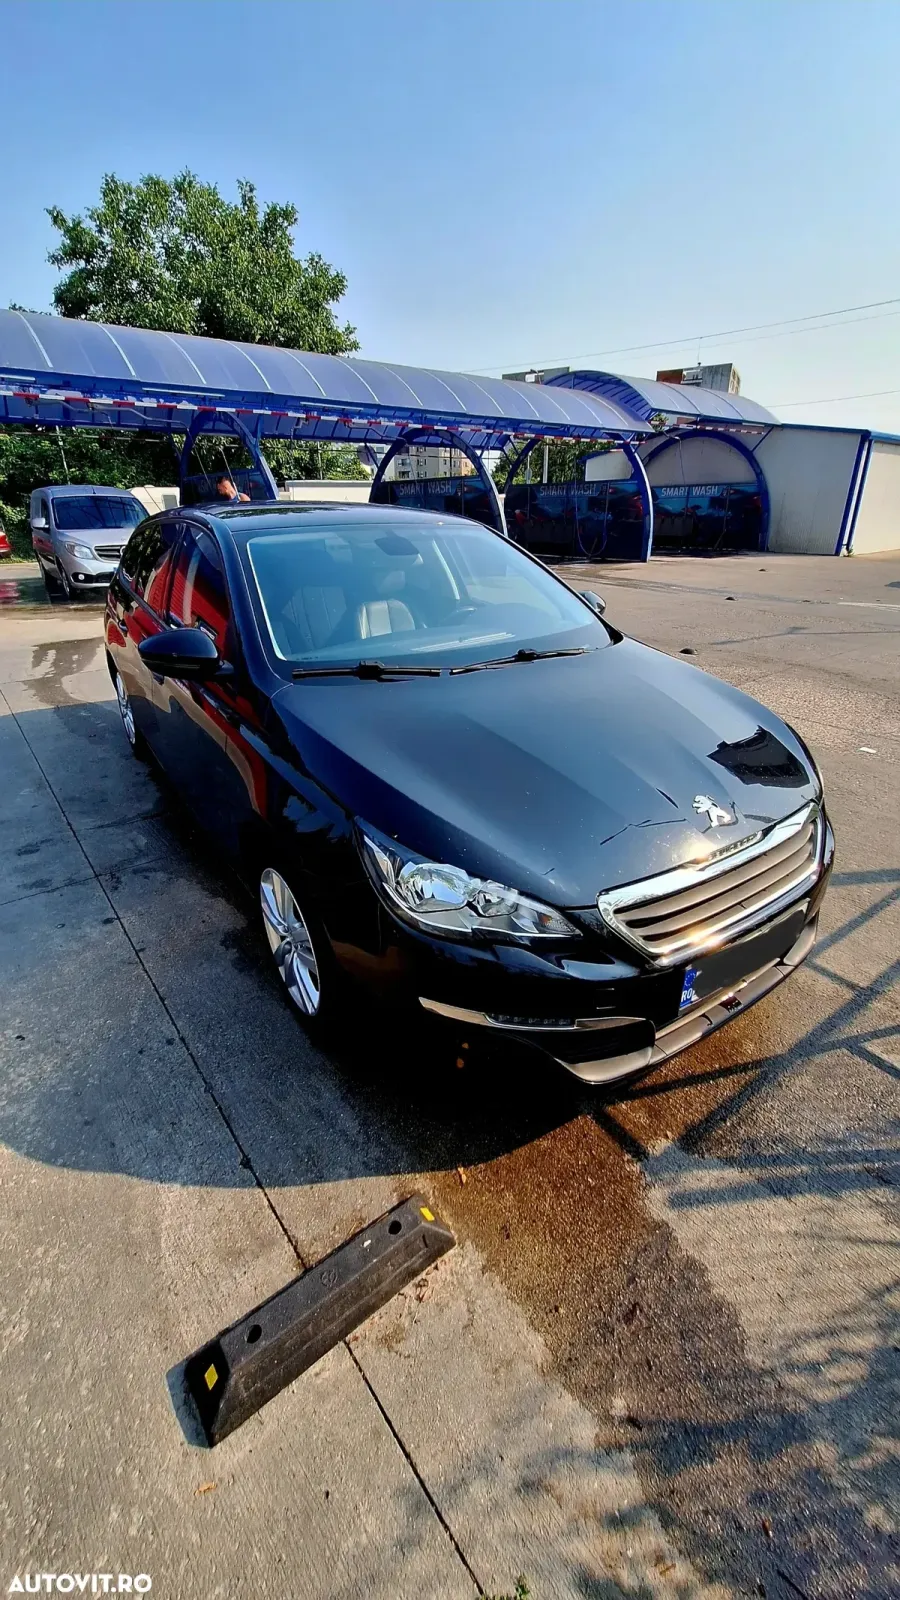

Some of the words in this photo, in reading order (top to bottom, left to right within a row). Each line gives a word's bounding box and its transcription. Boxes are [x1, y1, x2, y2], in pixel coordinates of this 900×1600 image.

[400, 483, 425, 495] SMART
[427, 481, 451, 494] WASH
[539, 485, 567, 496] SMART
[569, 484, 596, 495] WASH
[661, 487, 688, 497] SMART
[692, 486, 718, 496] WASH
[681, 987, 692, 1002] RO
